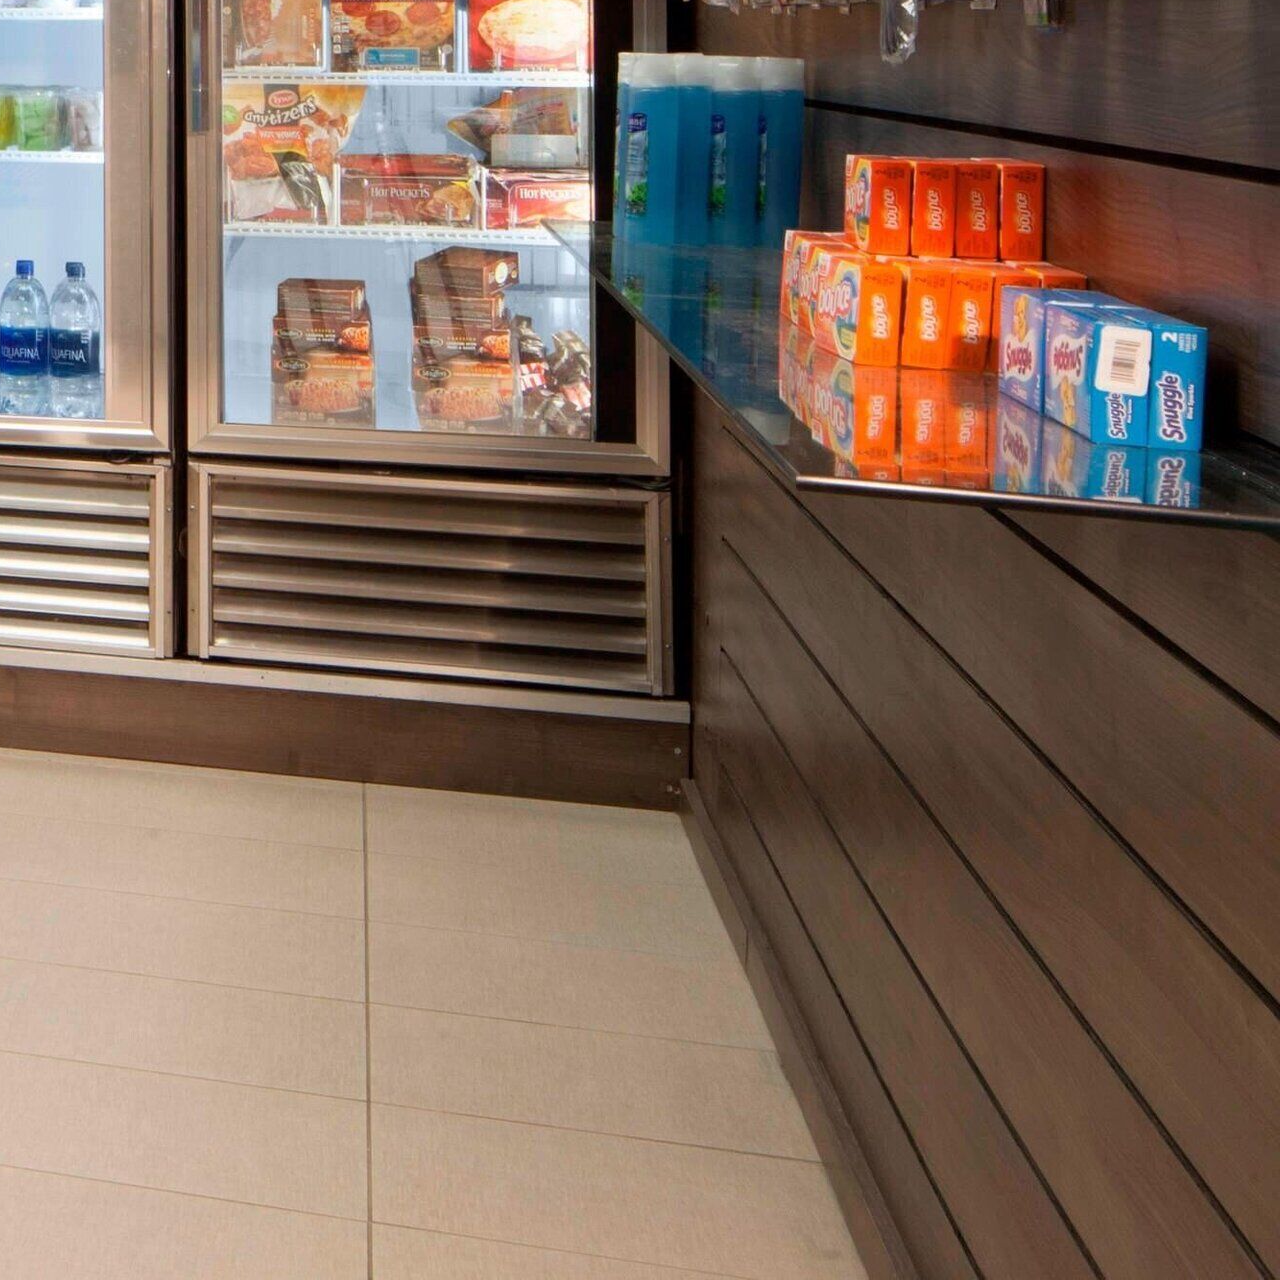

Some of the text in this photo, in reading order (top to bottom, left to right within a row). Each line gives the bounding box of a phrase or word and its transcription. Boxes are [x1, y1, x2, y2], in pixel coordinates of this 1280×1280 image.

[884, 189, 900, 230] bounce
[928, 190, 943, 231] bounce
[971, 191, 987, 232] bounce
[1017, 192, 1032, 234] bounce
[819, 285, 851, 315] bounce
[871, 294, 889, 339] bounce
[920, 296, 937, 341] bounce
[964, 300, 980, 344] bounce
[1162, 332, 1177, 343] 2
[1, 346, 40, 360] QUAFINA
[52, 347, 86, 363] UAFINA
[1006, 344, 1033, 376] Snuggle
[1106, 392, 1126, 439] Snuggle
[1158, 374, 1185, 441] Snuggle
